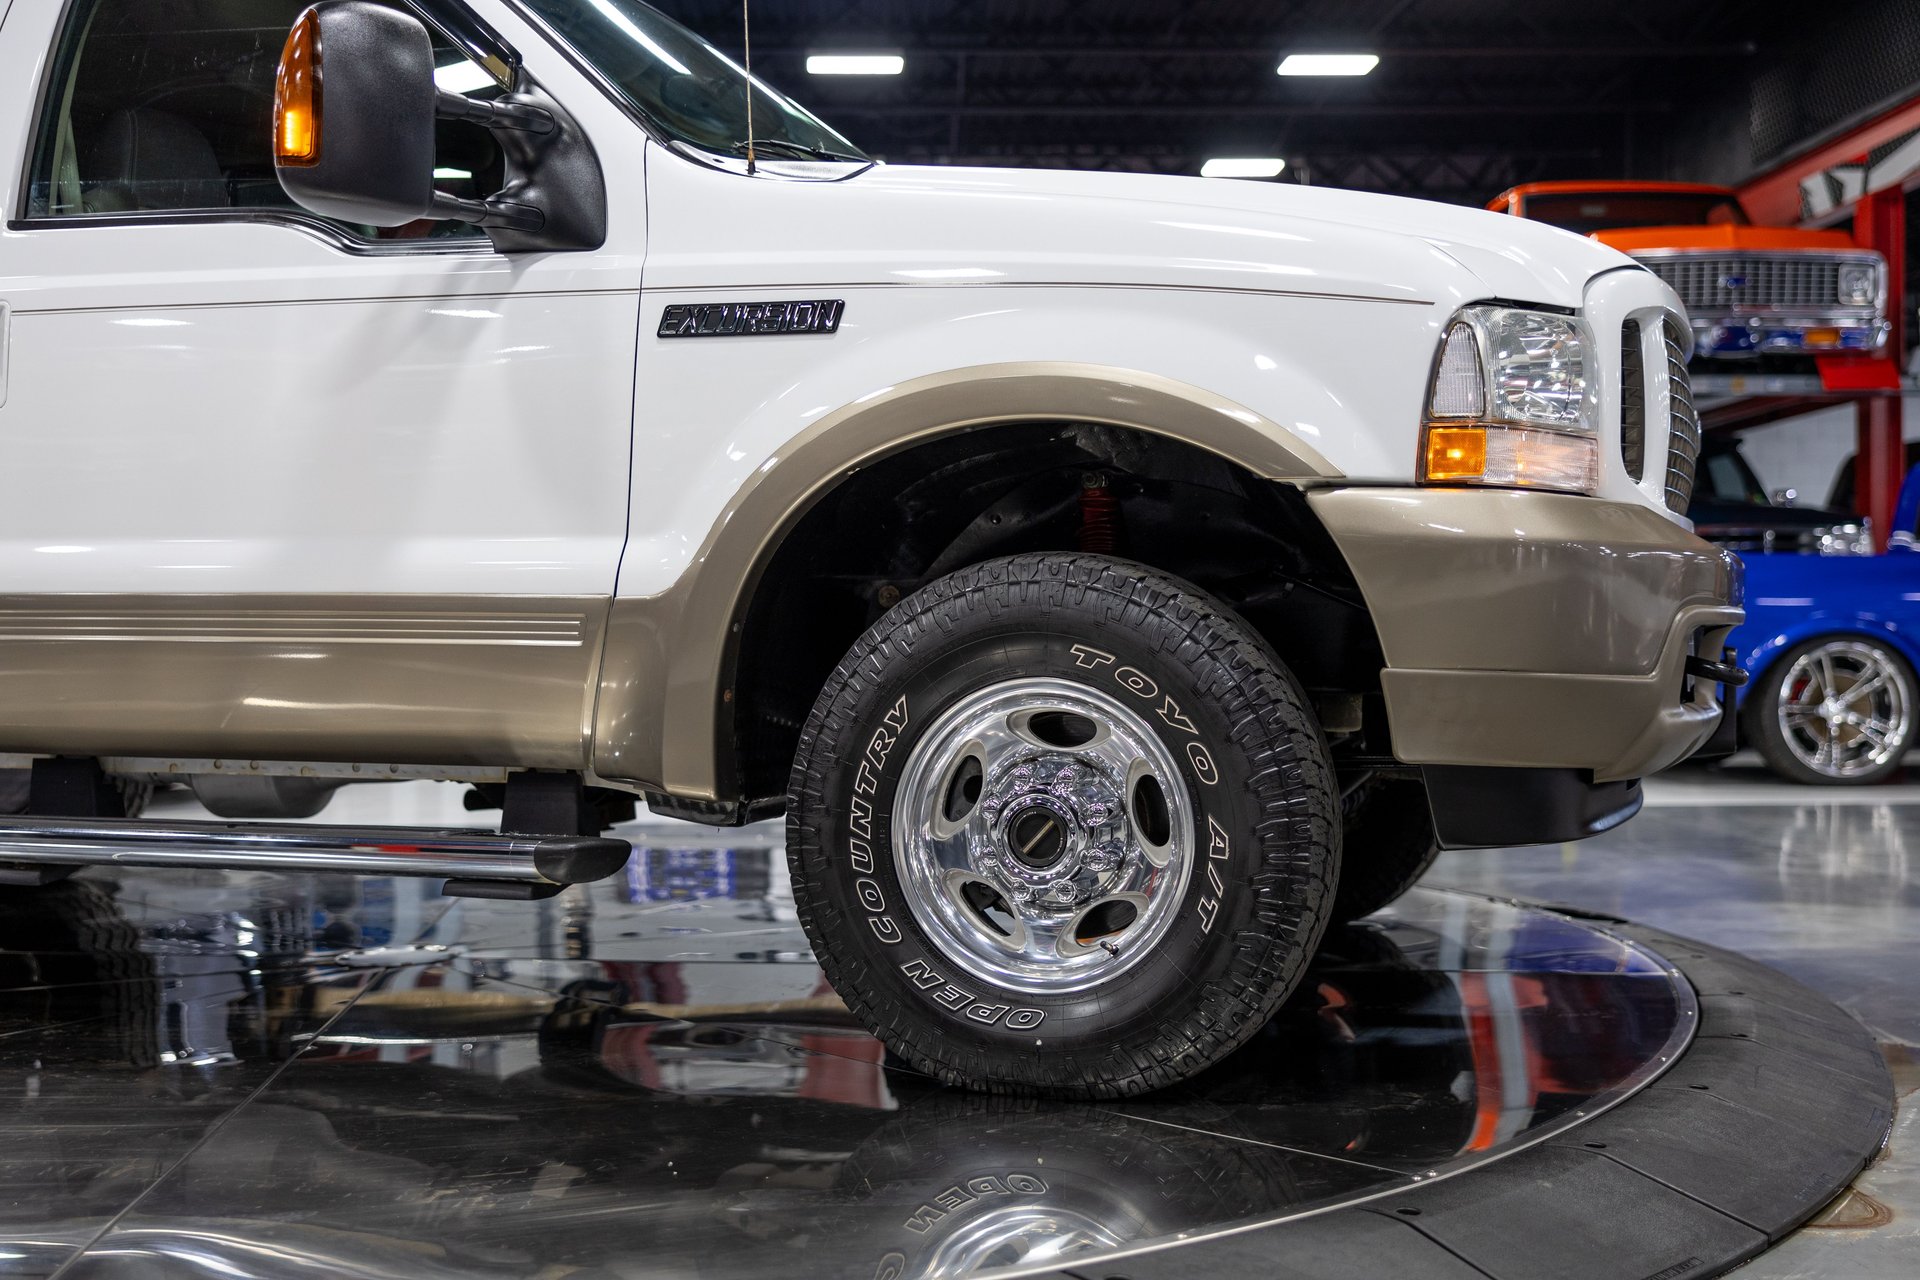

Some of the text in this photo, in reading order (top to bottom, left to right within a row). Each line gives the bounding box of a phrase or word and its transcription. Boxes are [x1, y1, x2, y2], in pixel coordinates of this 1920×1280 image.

[659, 301, 844, 335] EXCURSION
[849, 694, 908, 945] COUNTRY
[1069, 643, 1229, 935] TOYO A/T
[900, 957, 1049, 1031] OPEN
